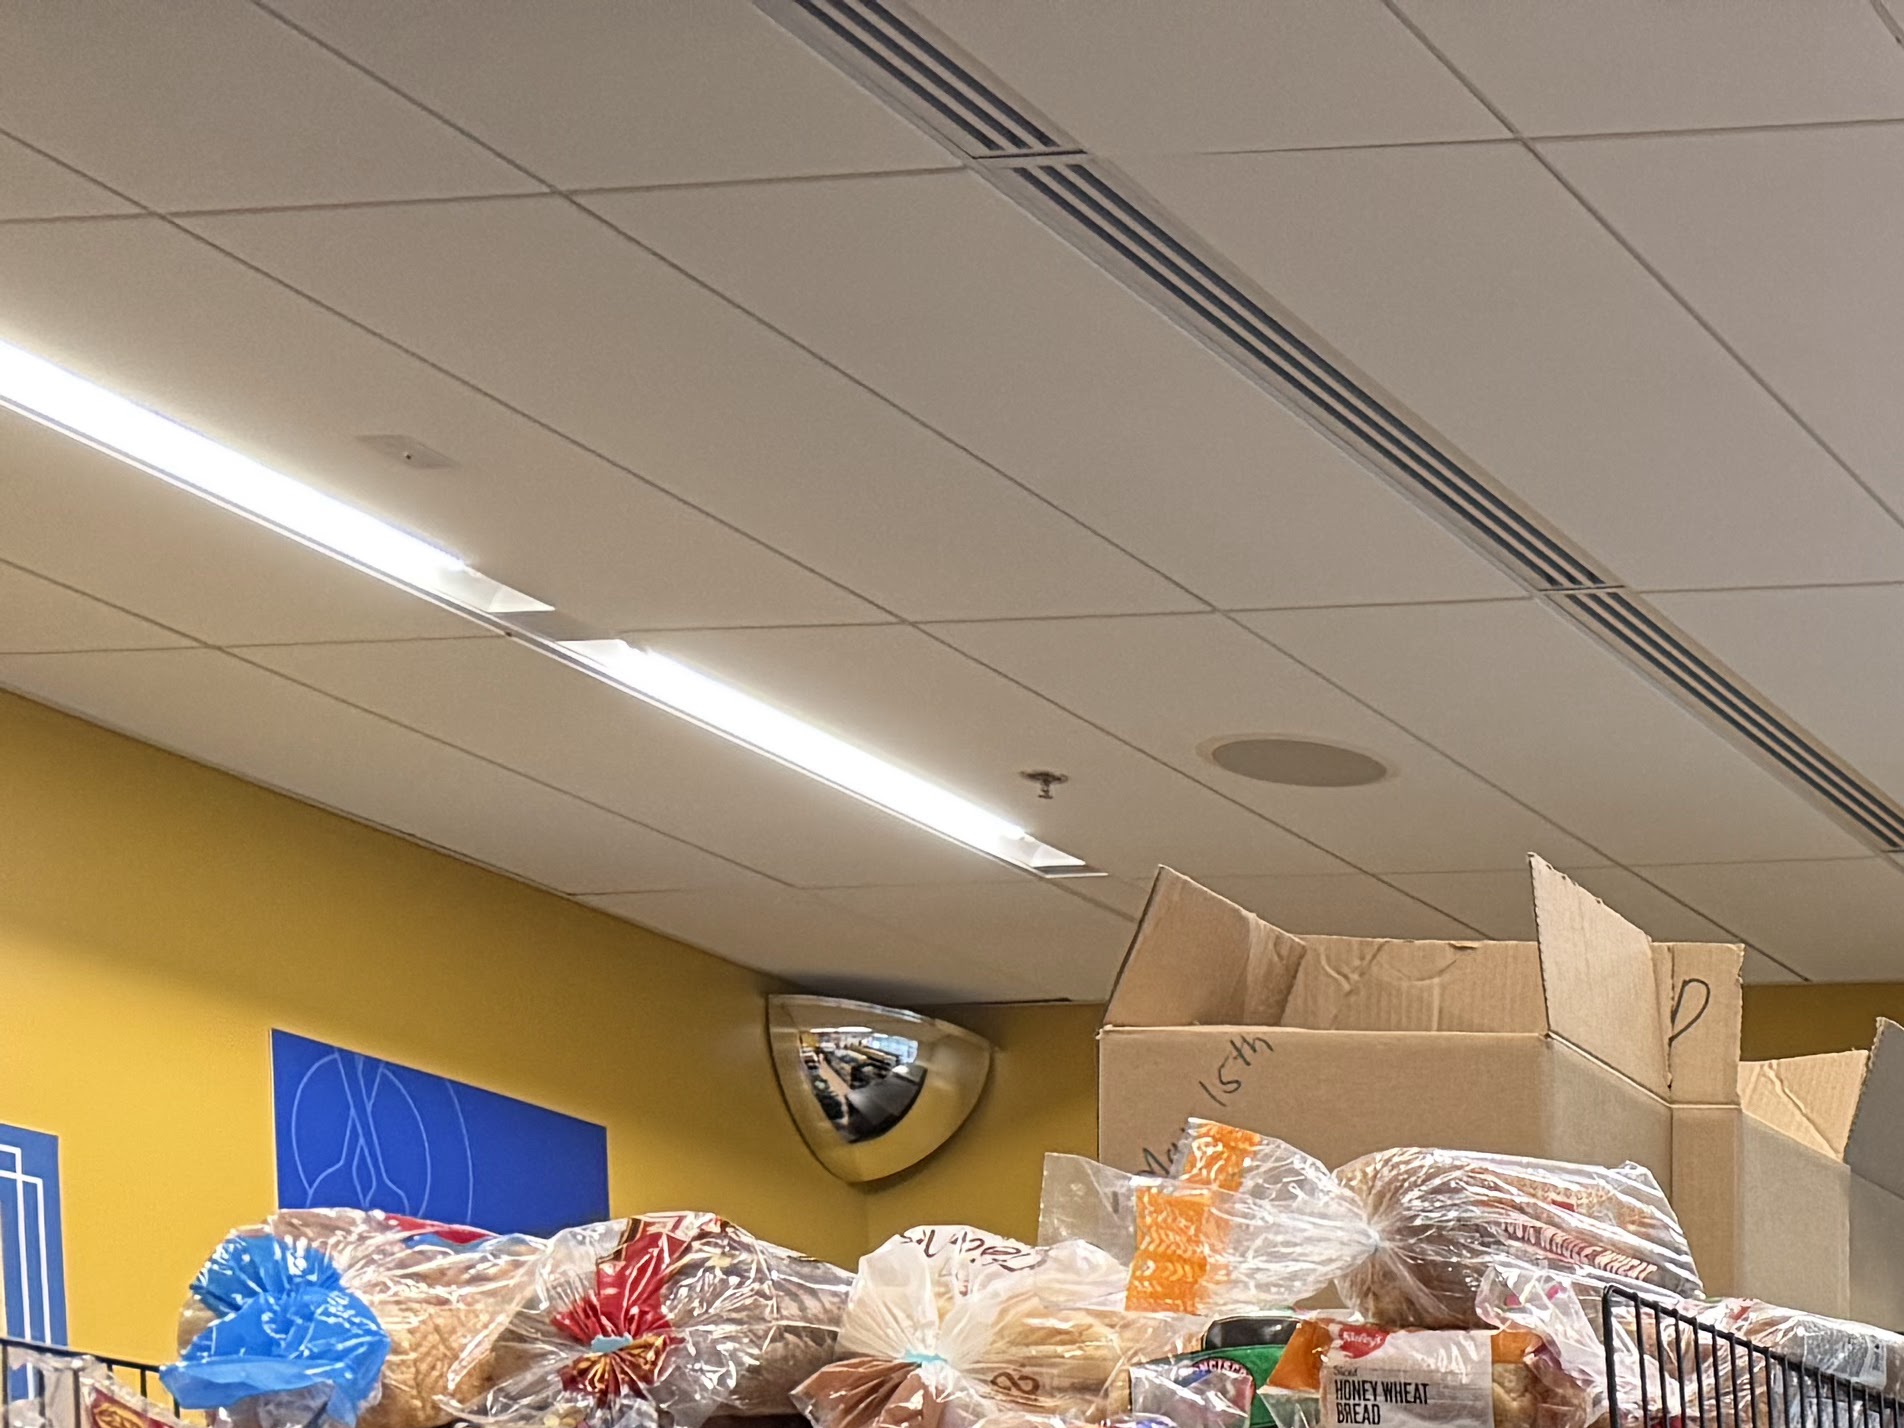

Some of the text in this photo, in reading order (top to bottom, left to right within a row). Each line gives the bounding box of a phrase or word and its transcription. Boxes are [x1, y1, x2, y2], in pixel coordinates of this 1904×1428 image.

[1198, 1034, 1274, 1107] 15th
[1335, 1379, 1430, 1405] HONEY WHEAT
[1337, 1402, 1381, 1425] BREAD
